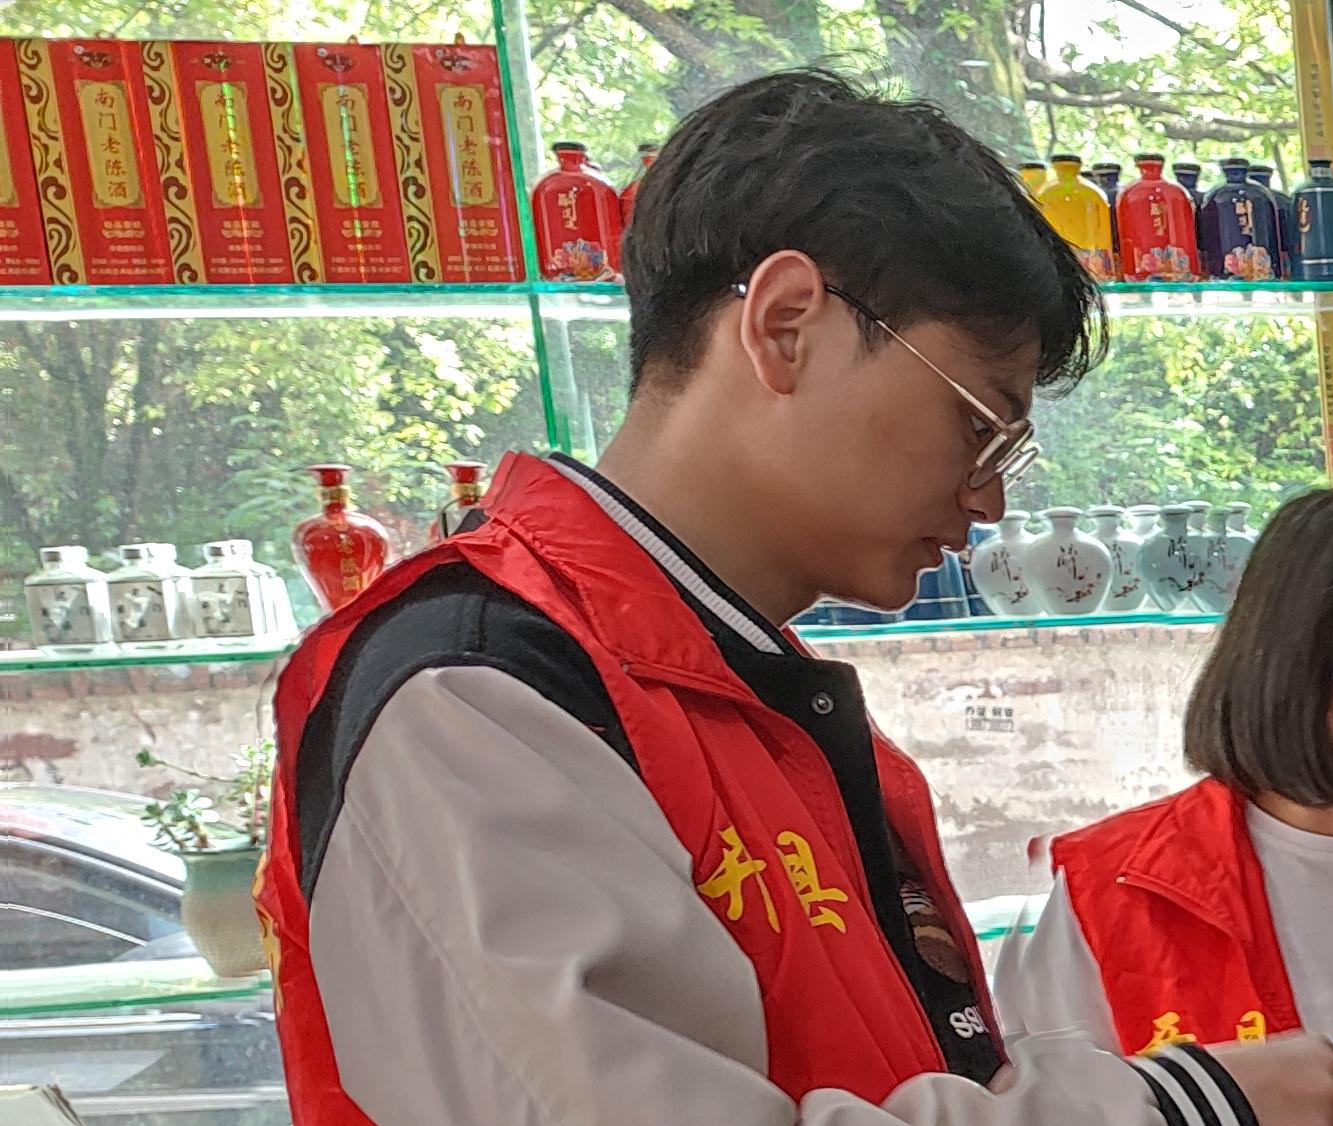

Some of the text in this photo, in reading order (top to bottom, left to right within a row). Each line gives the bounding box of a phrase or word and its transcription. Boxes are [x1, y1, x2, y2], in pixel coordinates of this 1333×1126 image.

[95, 89, 129, 200] 南门老陈酒
[453, 91, 484, 200] 南门老陈酒
